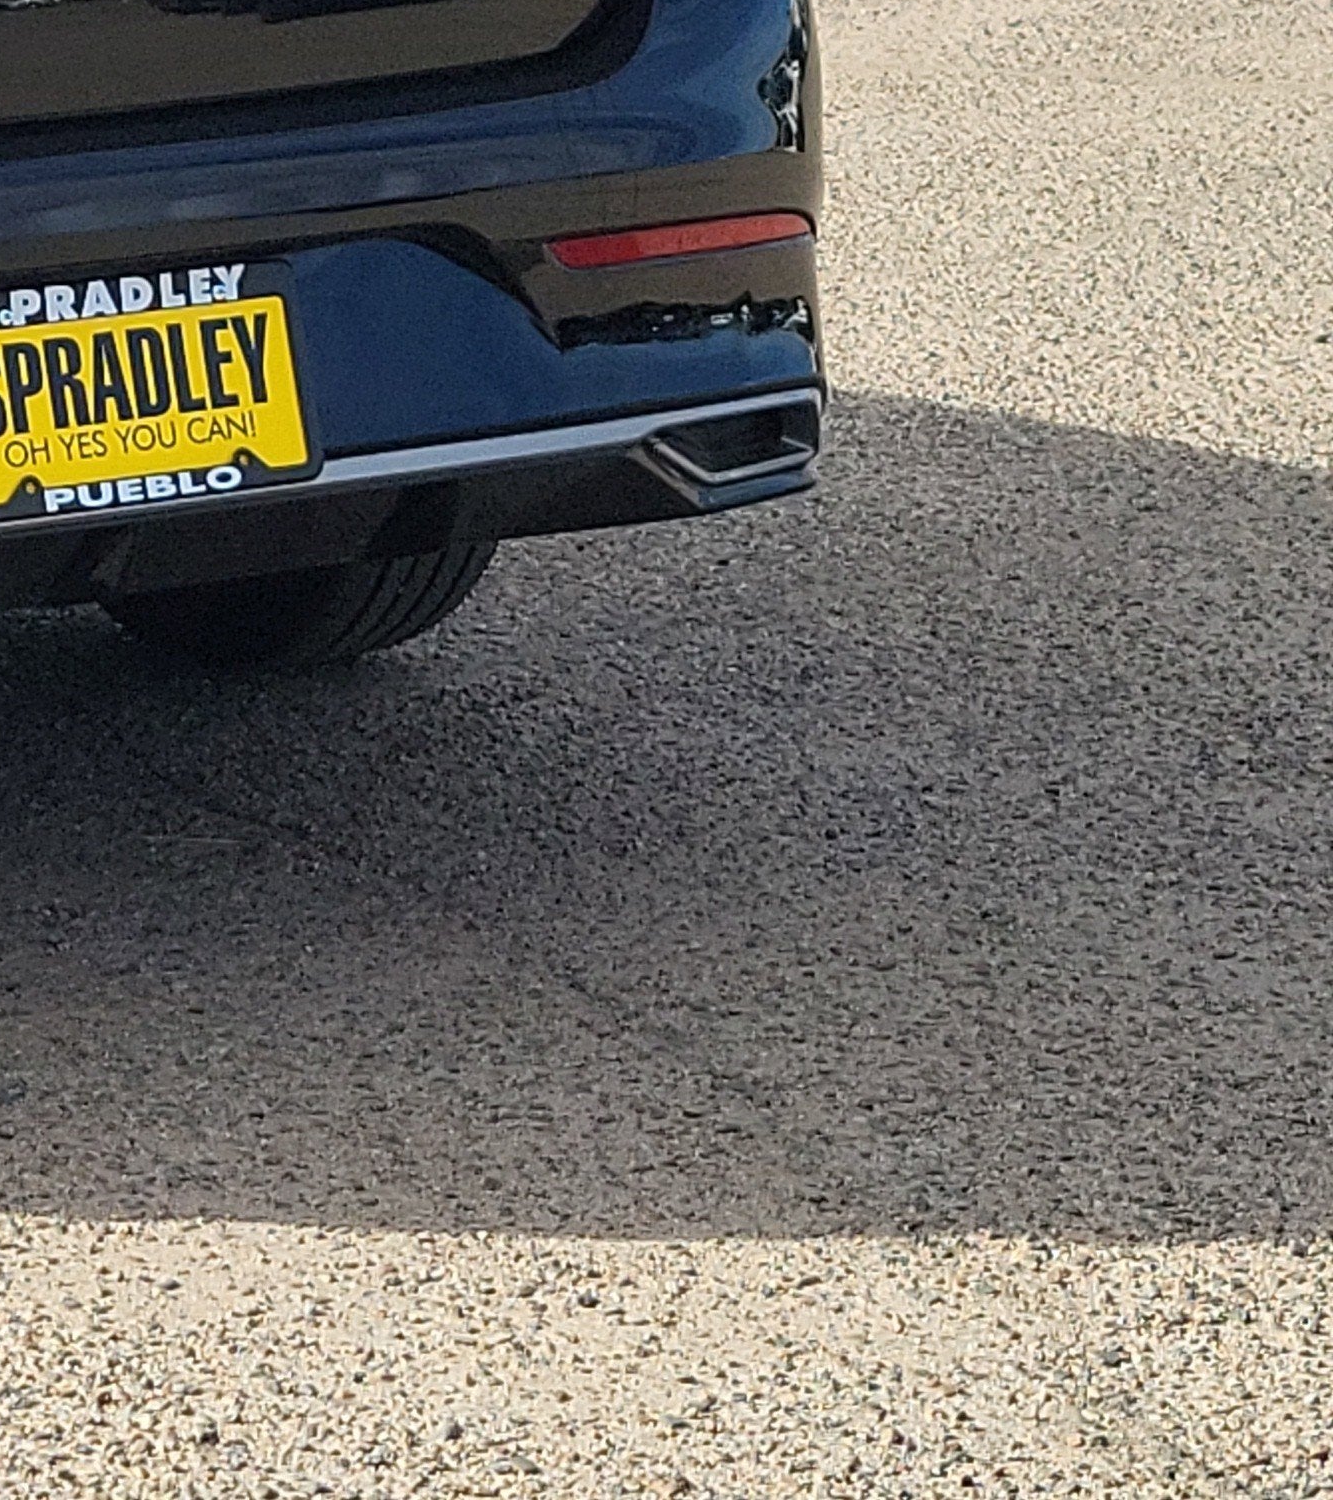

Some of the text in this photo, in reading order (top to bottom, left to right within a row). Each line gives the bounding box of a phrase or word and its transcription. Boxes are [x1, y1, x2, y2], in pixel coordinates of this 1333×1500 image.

[3, 410, 257, 468] OH YES YOU CAN!
[43, 464, 244, 514] PUEBLO
